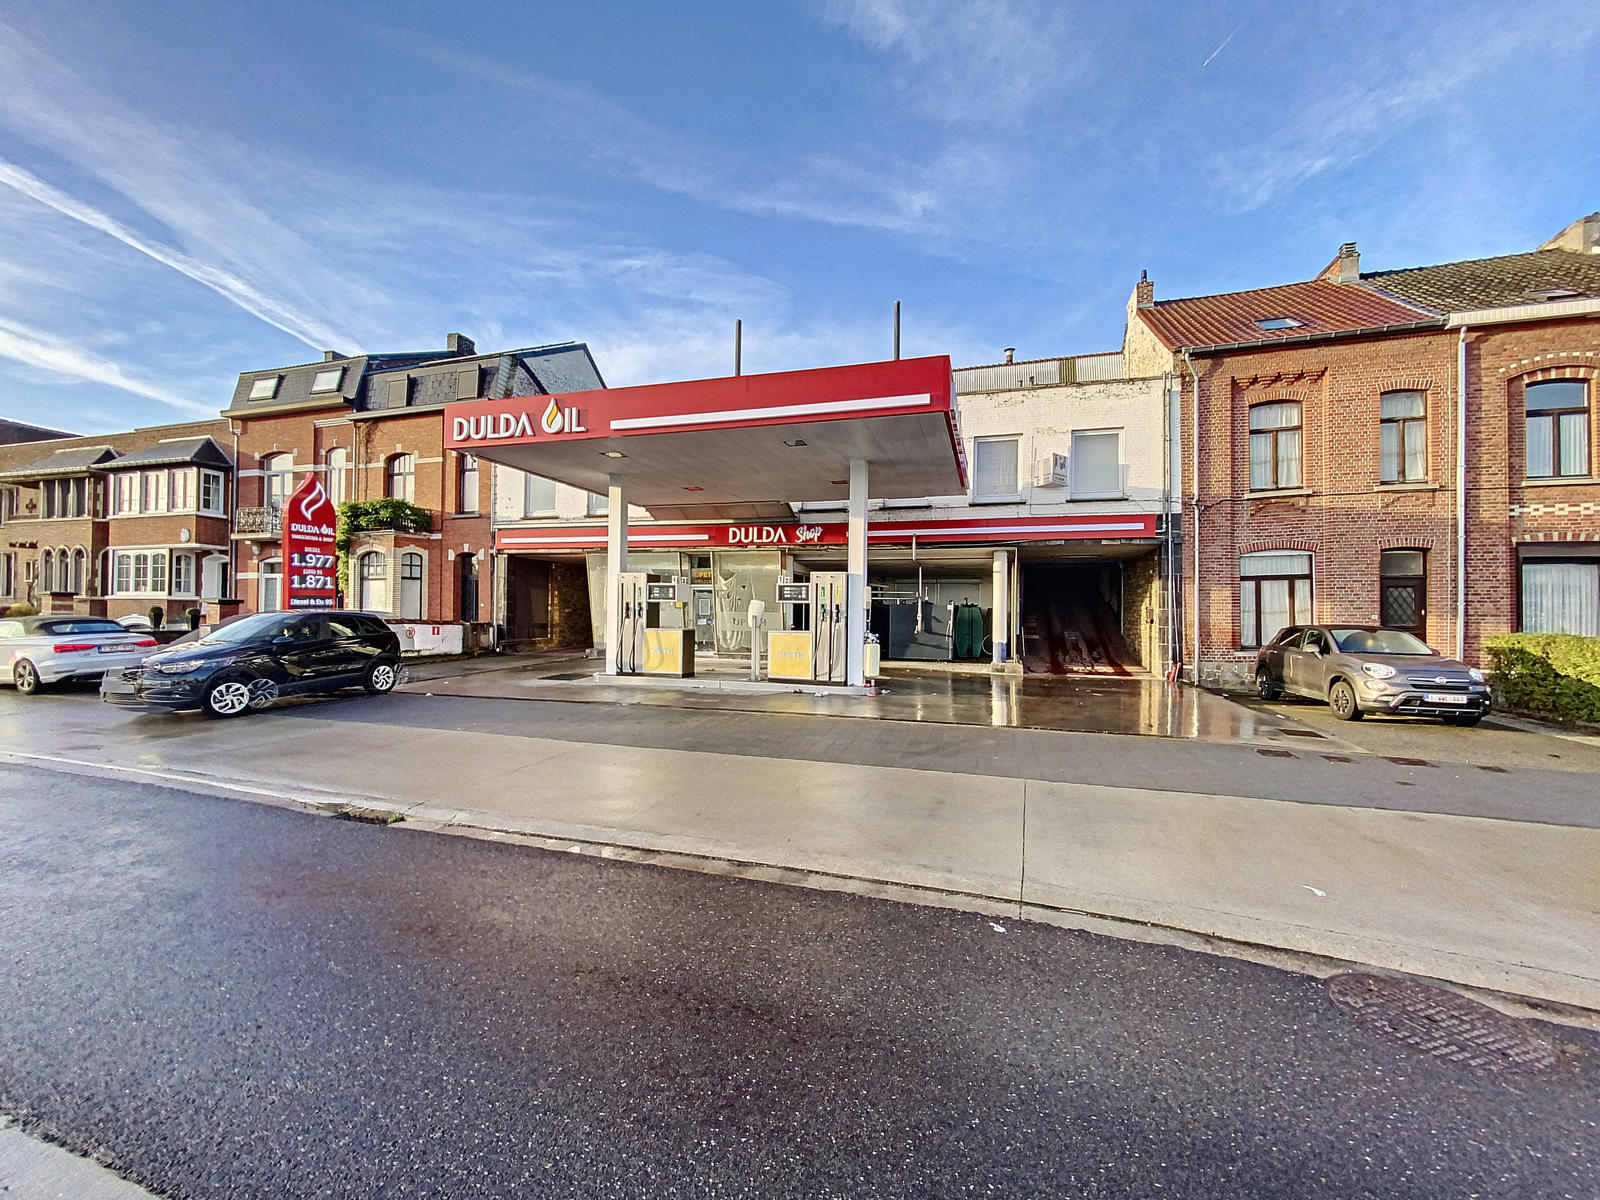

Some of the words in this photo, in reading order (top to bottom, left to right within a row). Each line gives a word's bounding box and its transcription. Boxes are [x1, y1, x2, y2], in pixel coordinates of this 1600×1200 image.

[453, 411, 535, 441] DULDA
[541, 397, 587, 434] OIL
[291, 524, 320, 534] DULDA
[728, 526, 787, 543] DULDA
[795, 525, 823, 543] Shop
[291, 553, 333, 568] 1.977
[291, 574, 333, 589] 1.871
[316, 598, 324, 606] Eu
